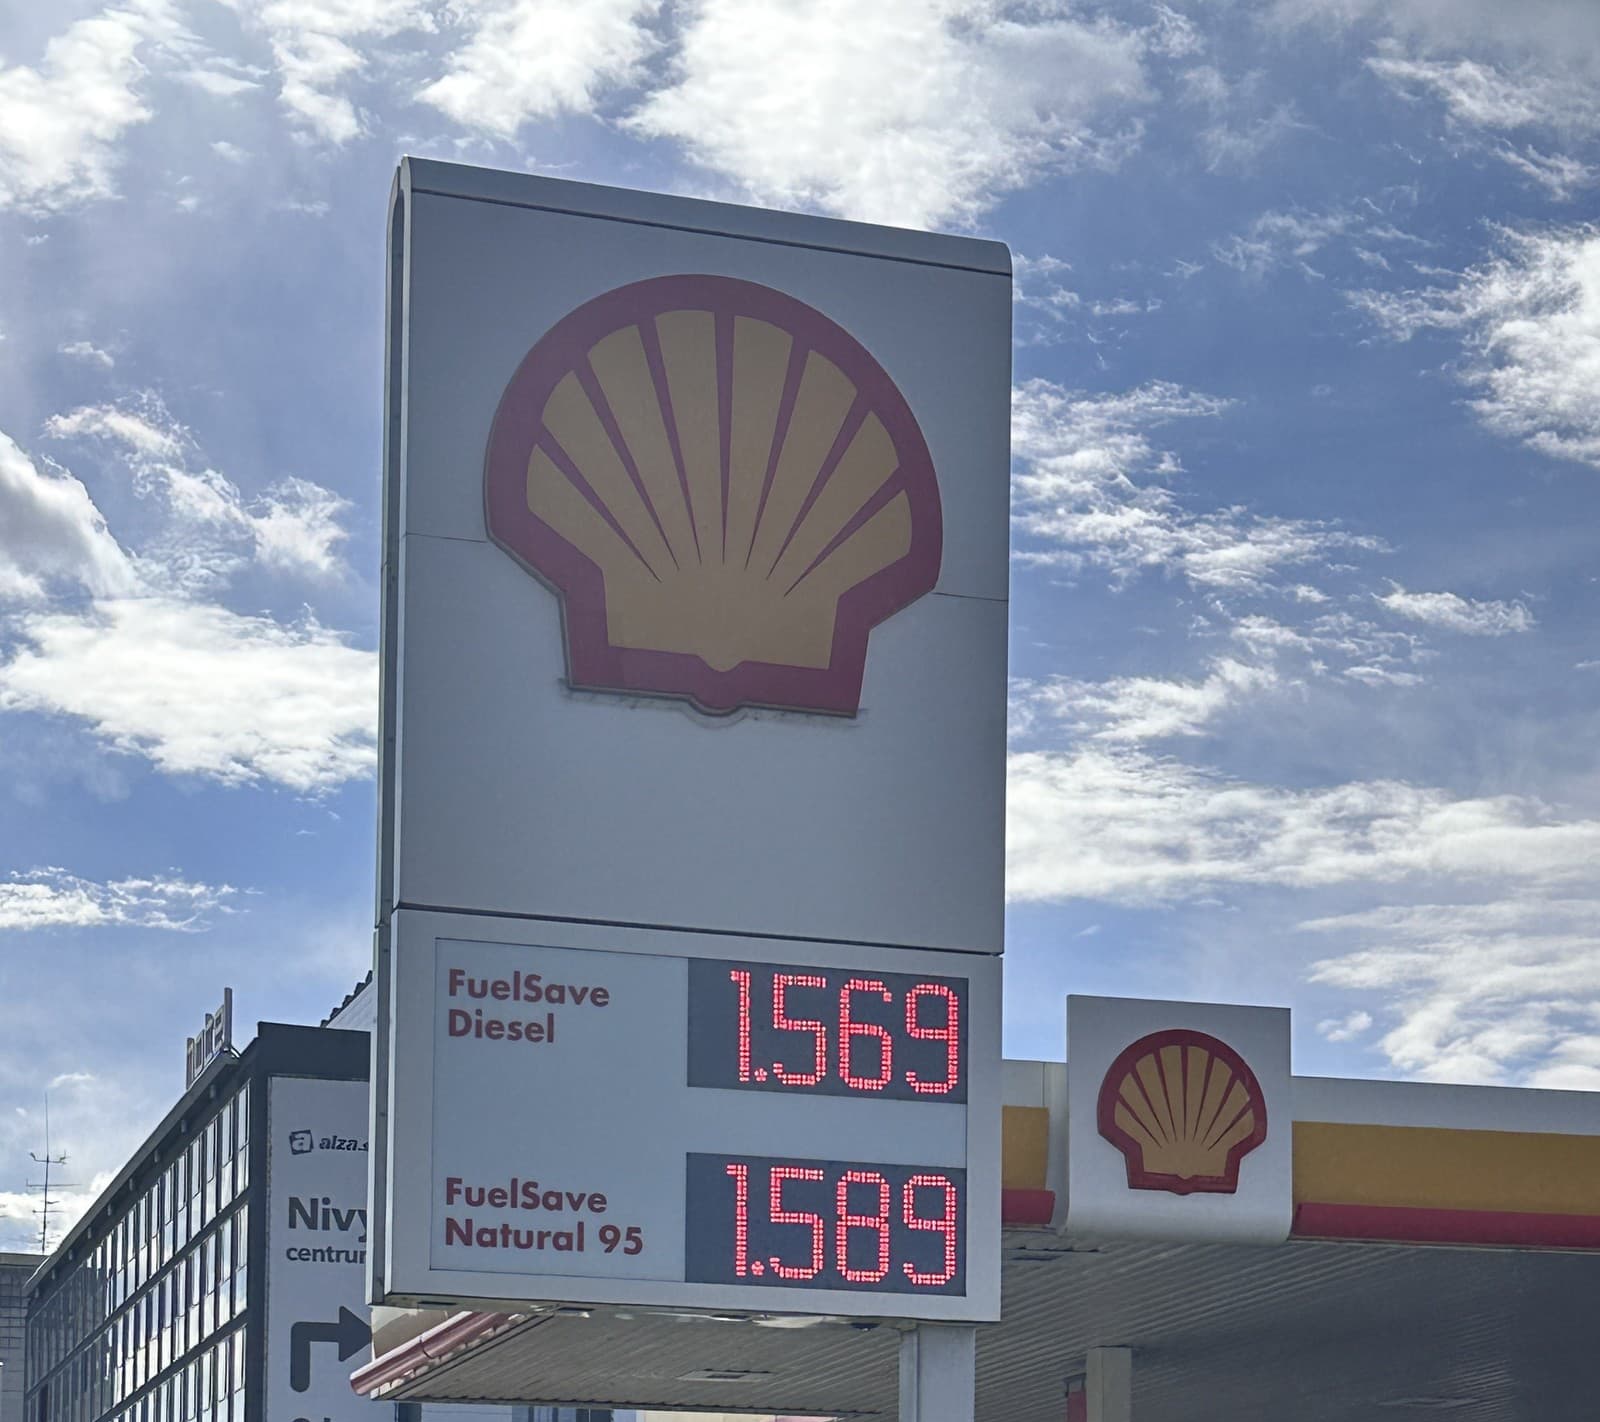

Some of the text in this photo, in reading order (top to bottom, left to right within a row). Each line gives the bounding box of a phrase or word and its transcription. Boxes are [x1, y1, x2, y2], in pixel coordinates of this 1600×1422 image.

[447, 968, 610, 1008] FuelSave
[447, 1009, 555, 1044] Diesel
[729, 969, 959, 1094] 1.569
[446, 1177, 607, 1214] FuelSave
[445, 1218, 644, 1257] Natural 95
[726, 1162, 958, 1286] 1.589
